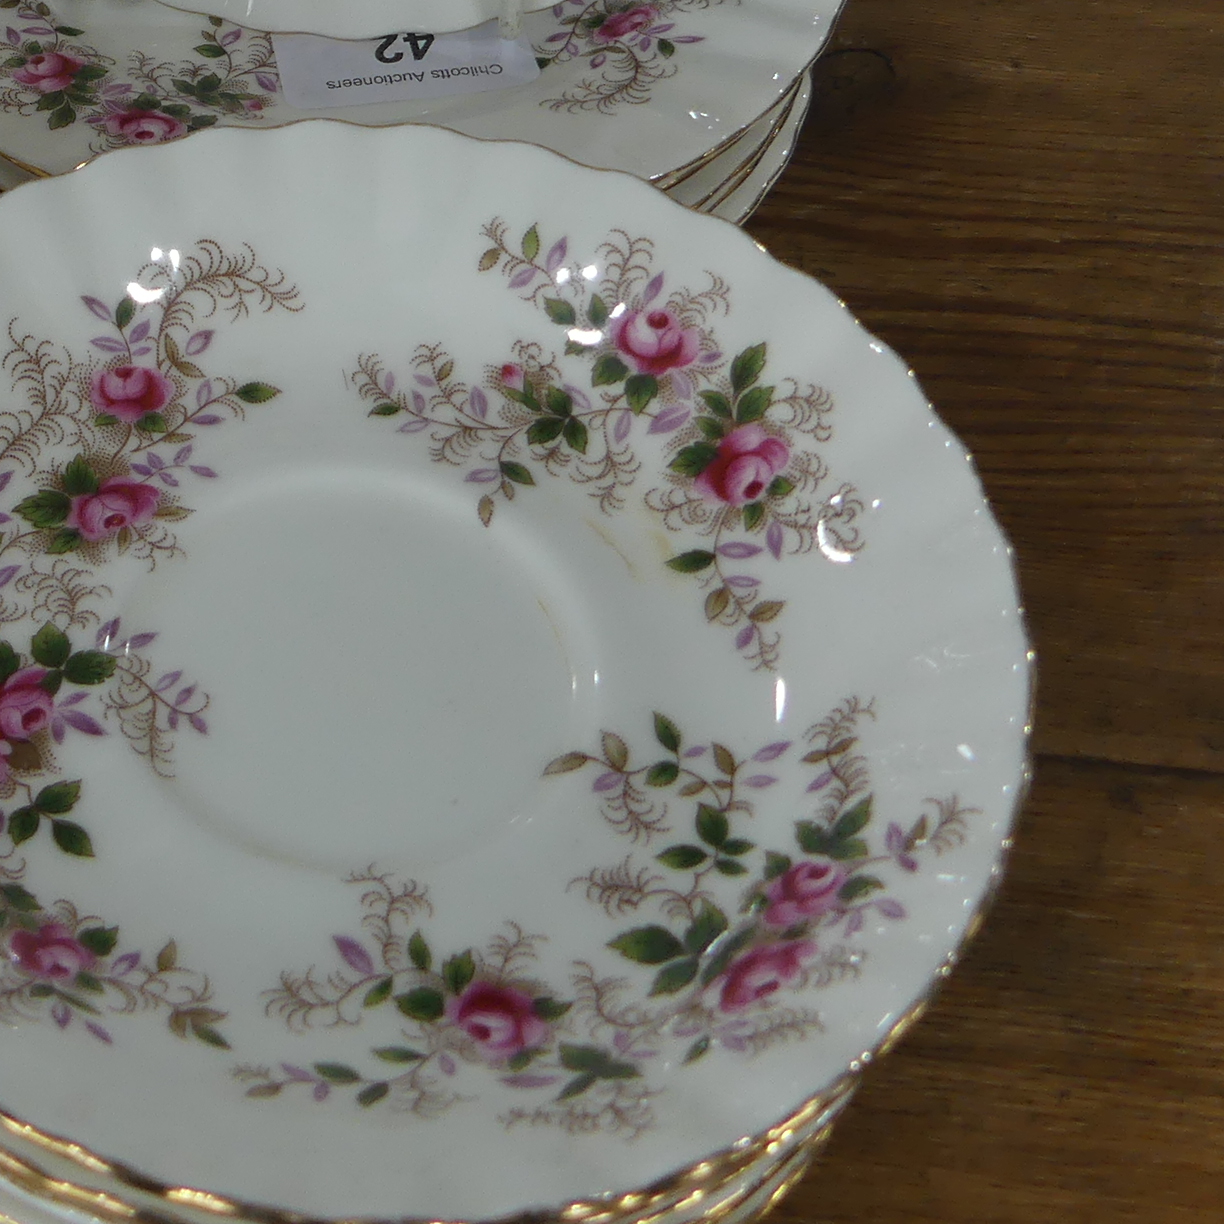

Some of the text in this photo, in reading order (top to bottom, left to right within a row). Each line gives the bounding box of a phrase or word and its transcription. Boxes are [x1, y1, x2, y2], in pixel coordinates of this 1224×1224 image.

[374, 32, 435, 64] 42
[326, 63, 503, 89] Chilcotts Auctioneers
